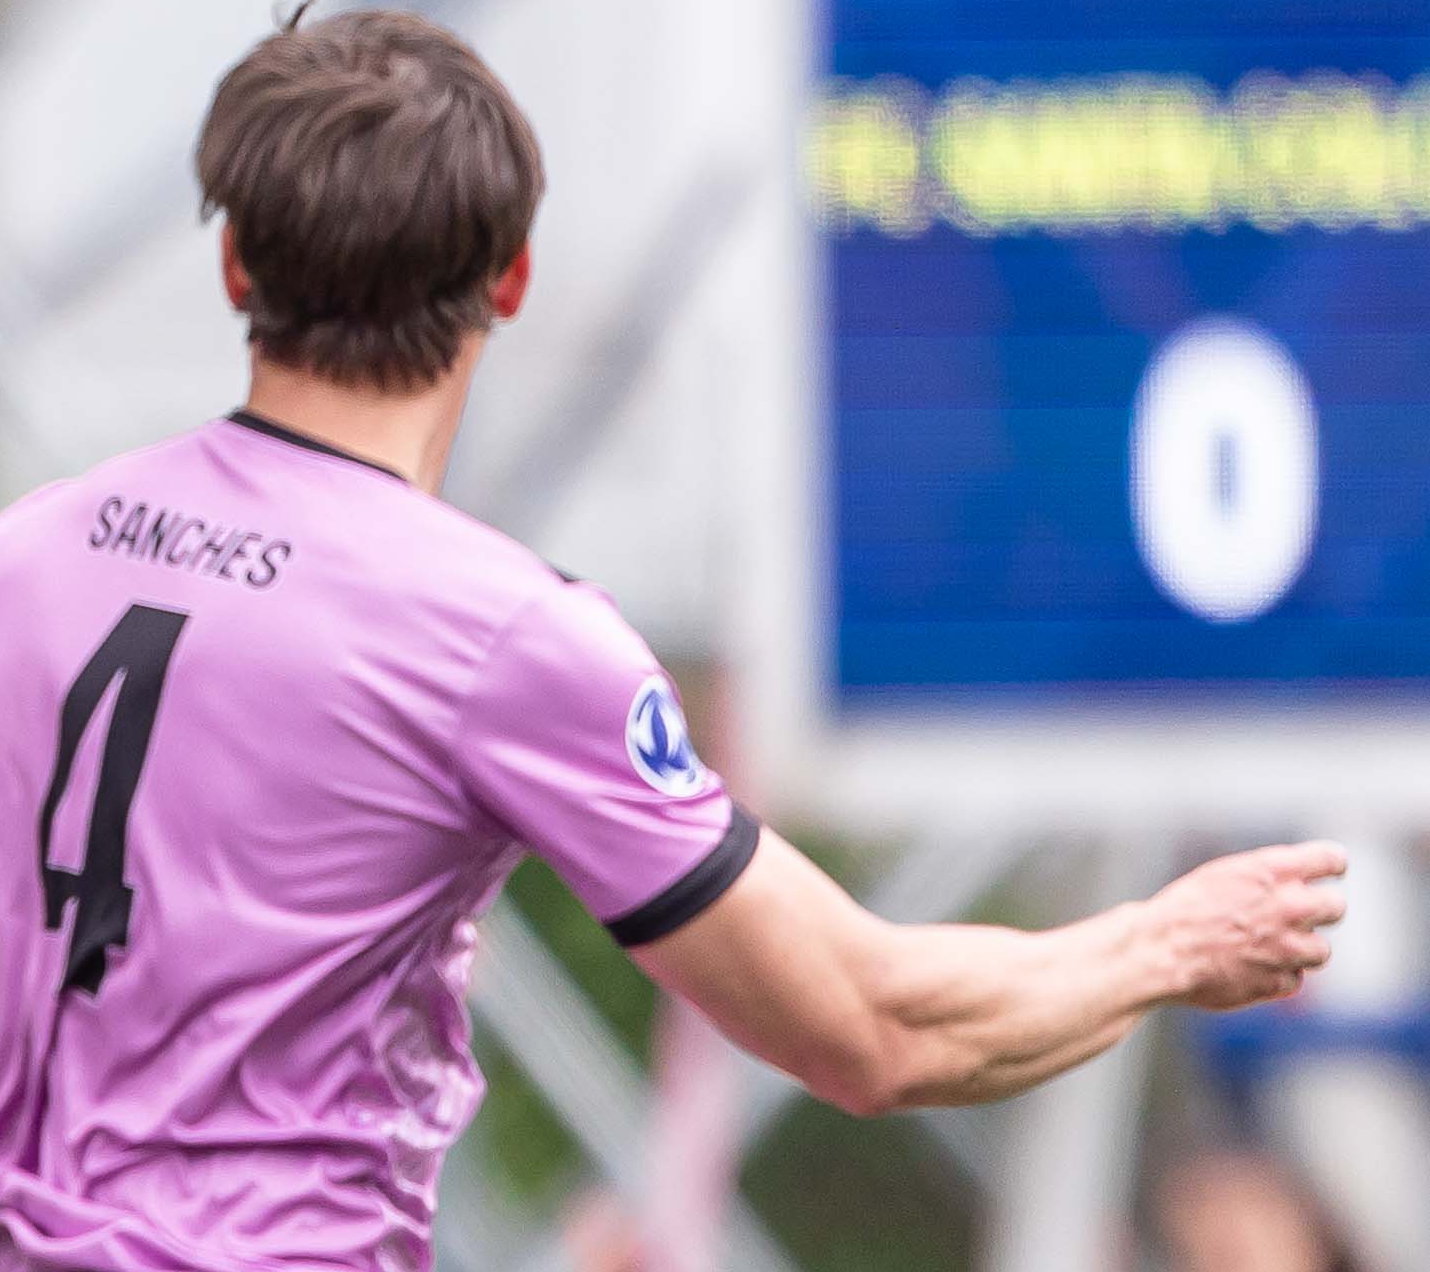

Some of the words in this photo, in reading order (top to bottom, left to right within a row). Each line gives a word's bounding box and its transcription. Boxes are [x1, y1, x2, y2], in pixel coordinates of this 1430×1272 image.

[89, 497, 291, 590] SANCHES
[1127, 313, 1321, 624] 0
[39, 602, 189, 997] 4
